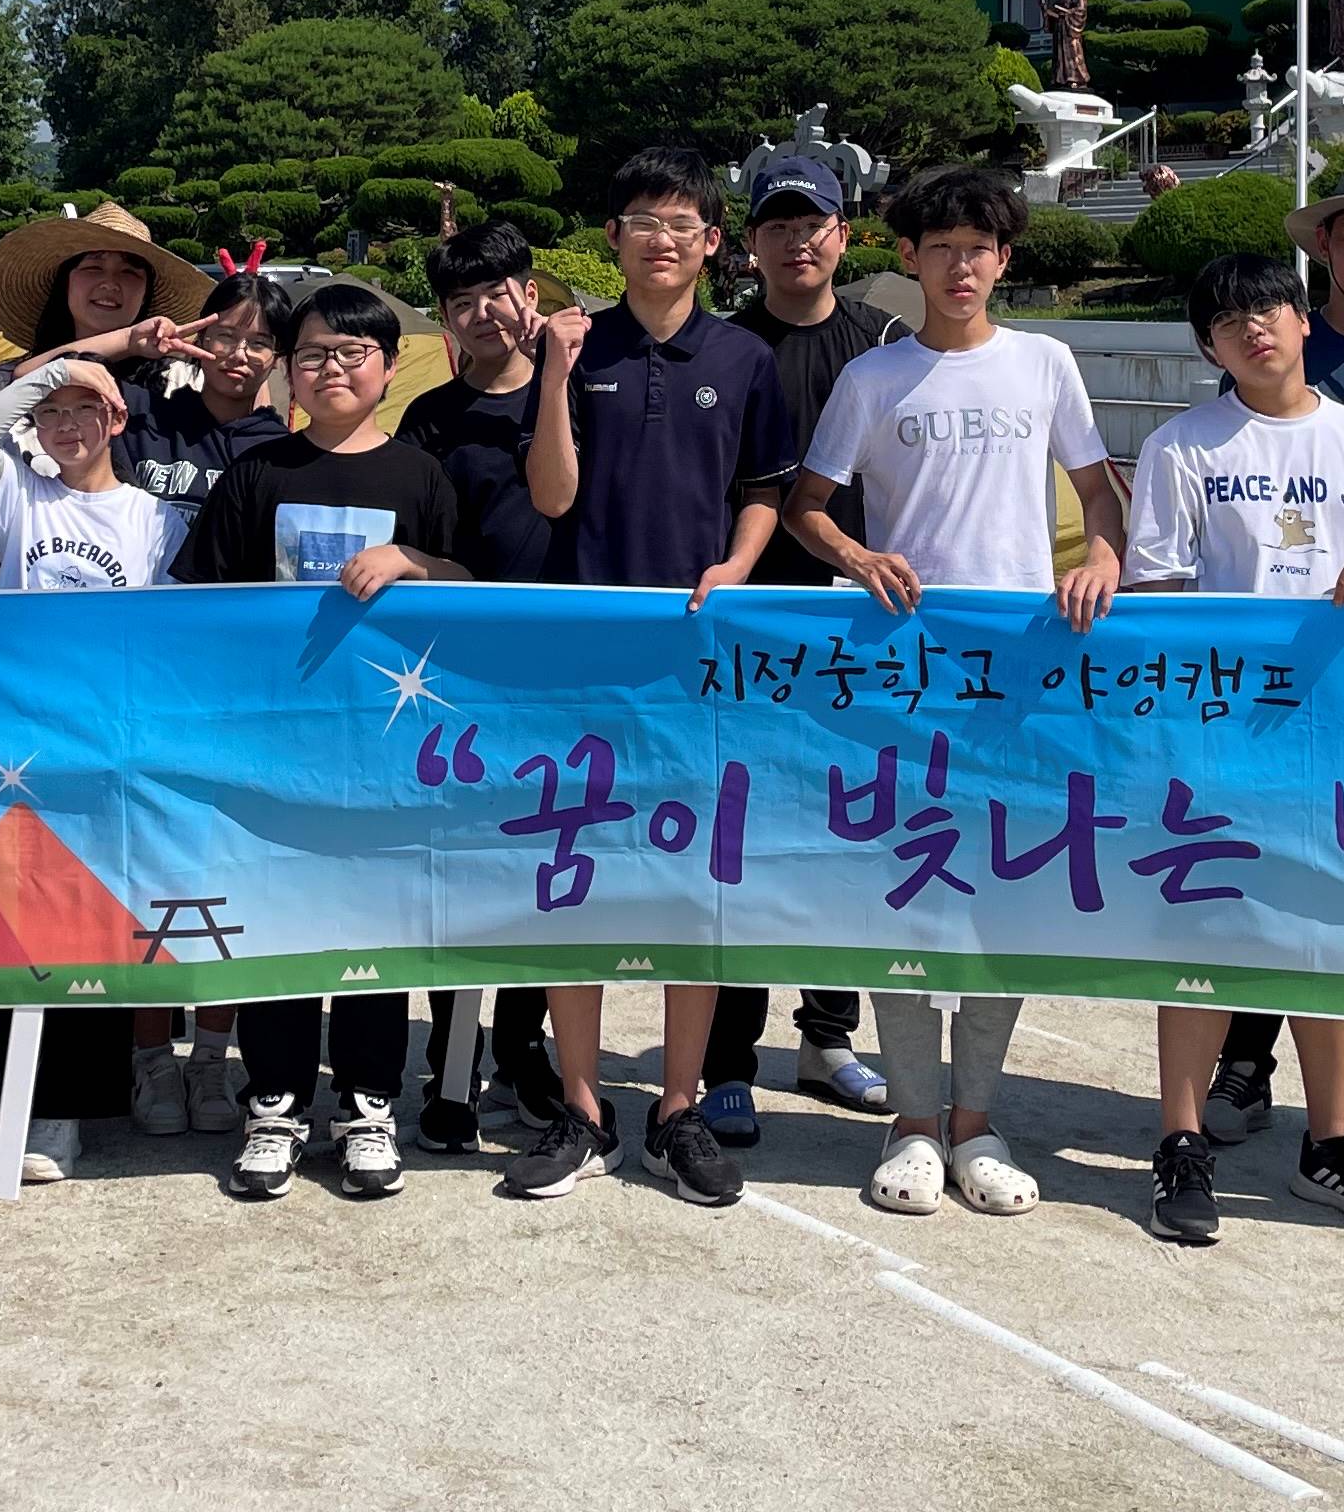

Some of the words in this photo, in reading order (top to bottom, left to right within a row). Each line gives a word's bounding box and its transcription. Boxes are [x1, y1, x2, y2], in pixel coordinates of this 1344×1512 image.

[896, 407, 1033, 448] GUESS
[136, 459, 199, 494] NEW
[1204, 475, 1273, 505] PEACE
[1284, 475, 1328, 505] AND
[25, 539, 49, 573] HE
[696, 631, 1006, 711] 지정중학교
[1041, 646, 1303, 724] 야영캠프
[828, 730, 1261, 913] 빛나는
